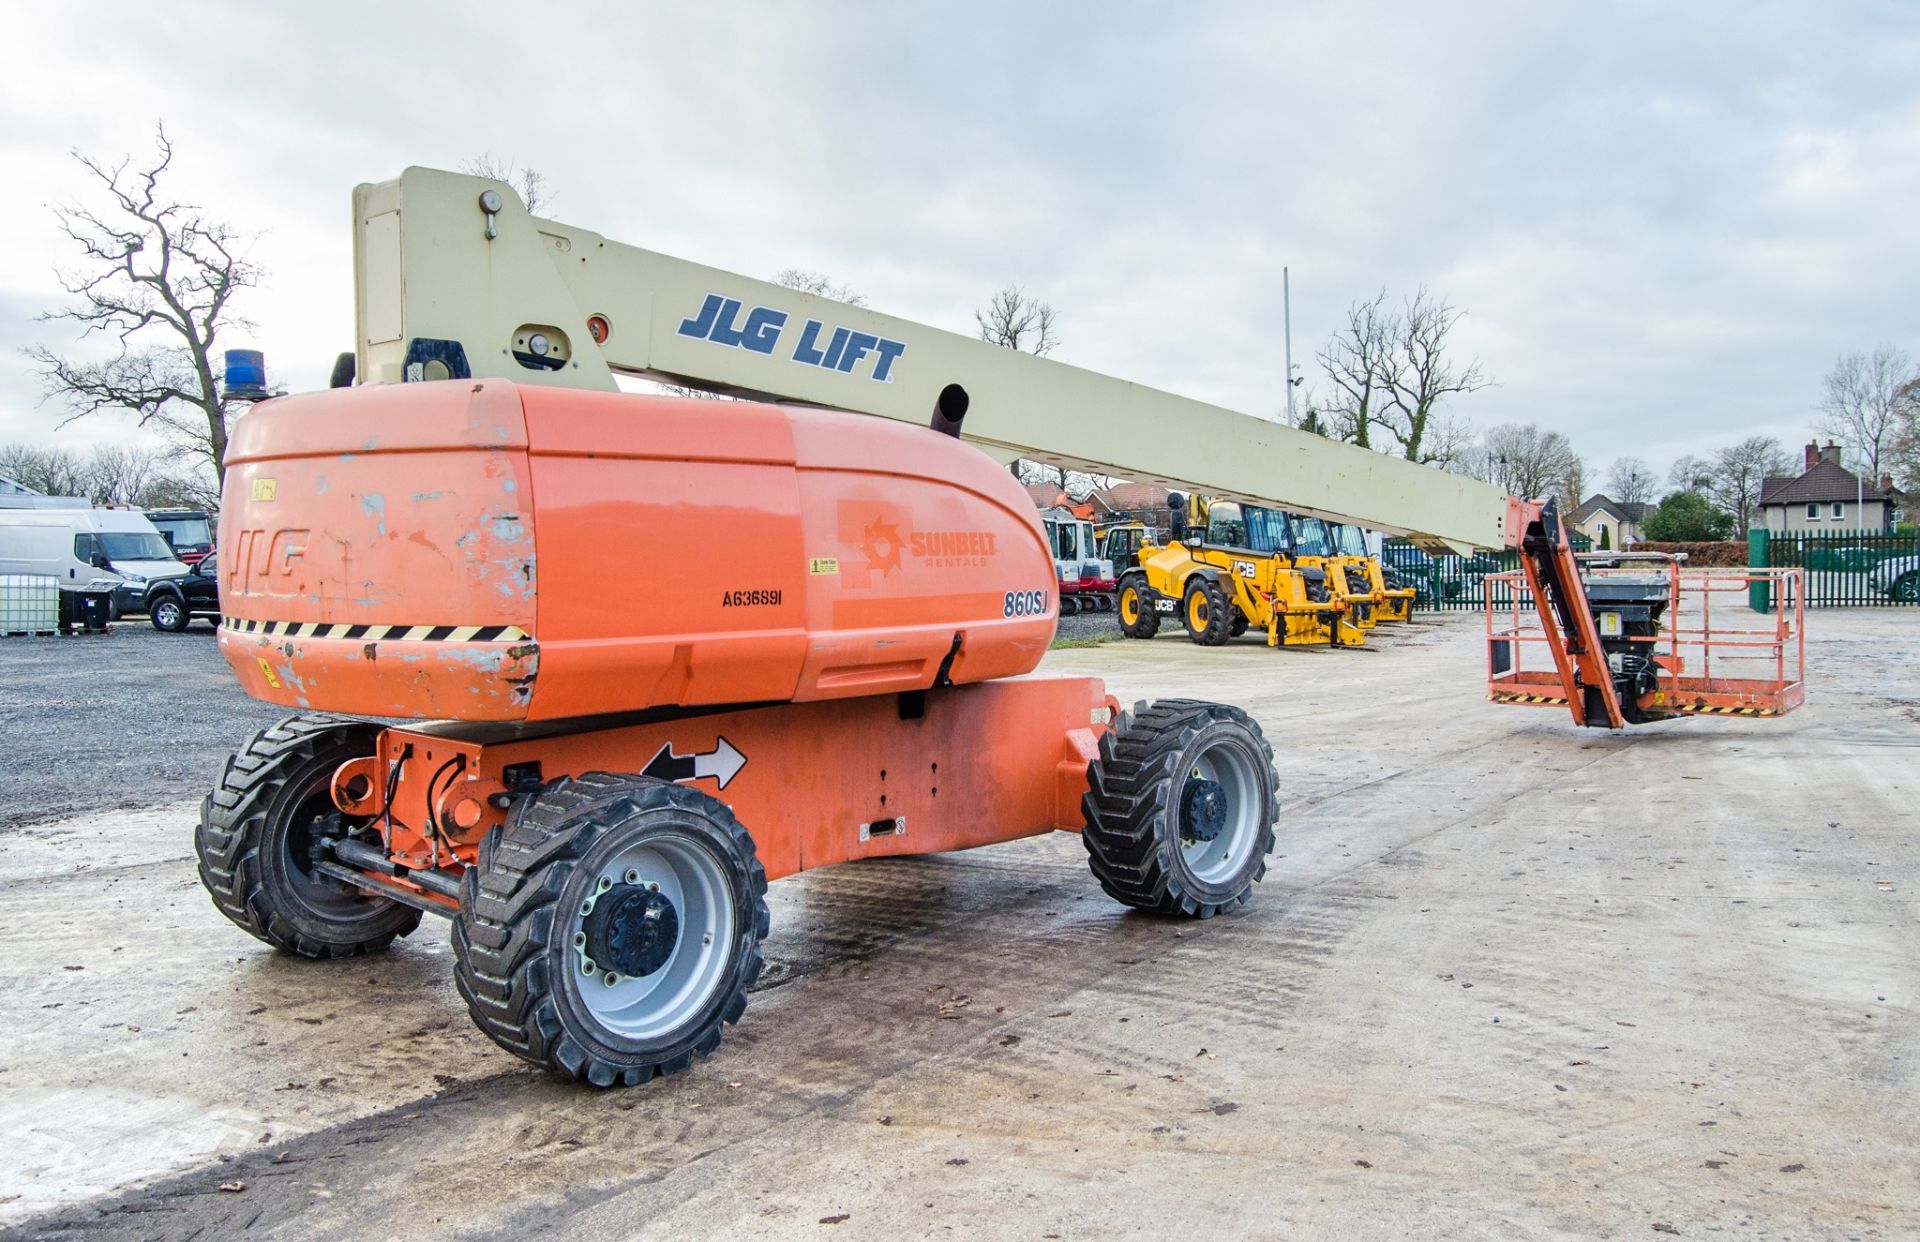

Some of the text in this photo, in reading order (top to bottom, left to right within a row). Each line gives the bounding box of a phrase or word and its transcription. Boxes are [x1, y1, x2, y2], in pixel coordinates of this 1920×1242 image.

[676, 292, 906, 382] JLG LIFT
[911, 531, 996, 556] SUNBELT
[925, 557, 987, 568] RENTALS
[1003, 590, 1048, 618] 860SJ
[1155, 599, 1174, 612] JCB
